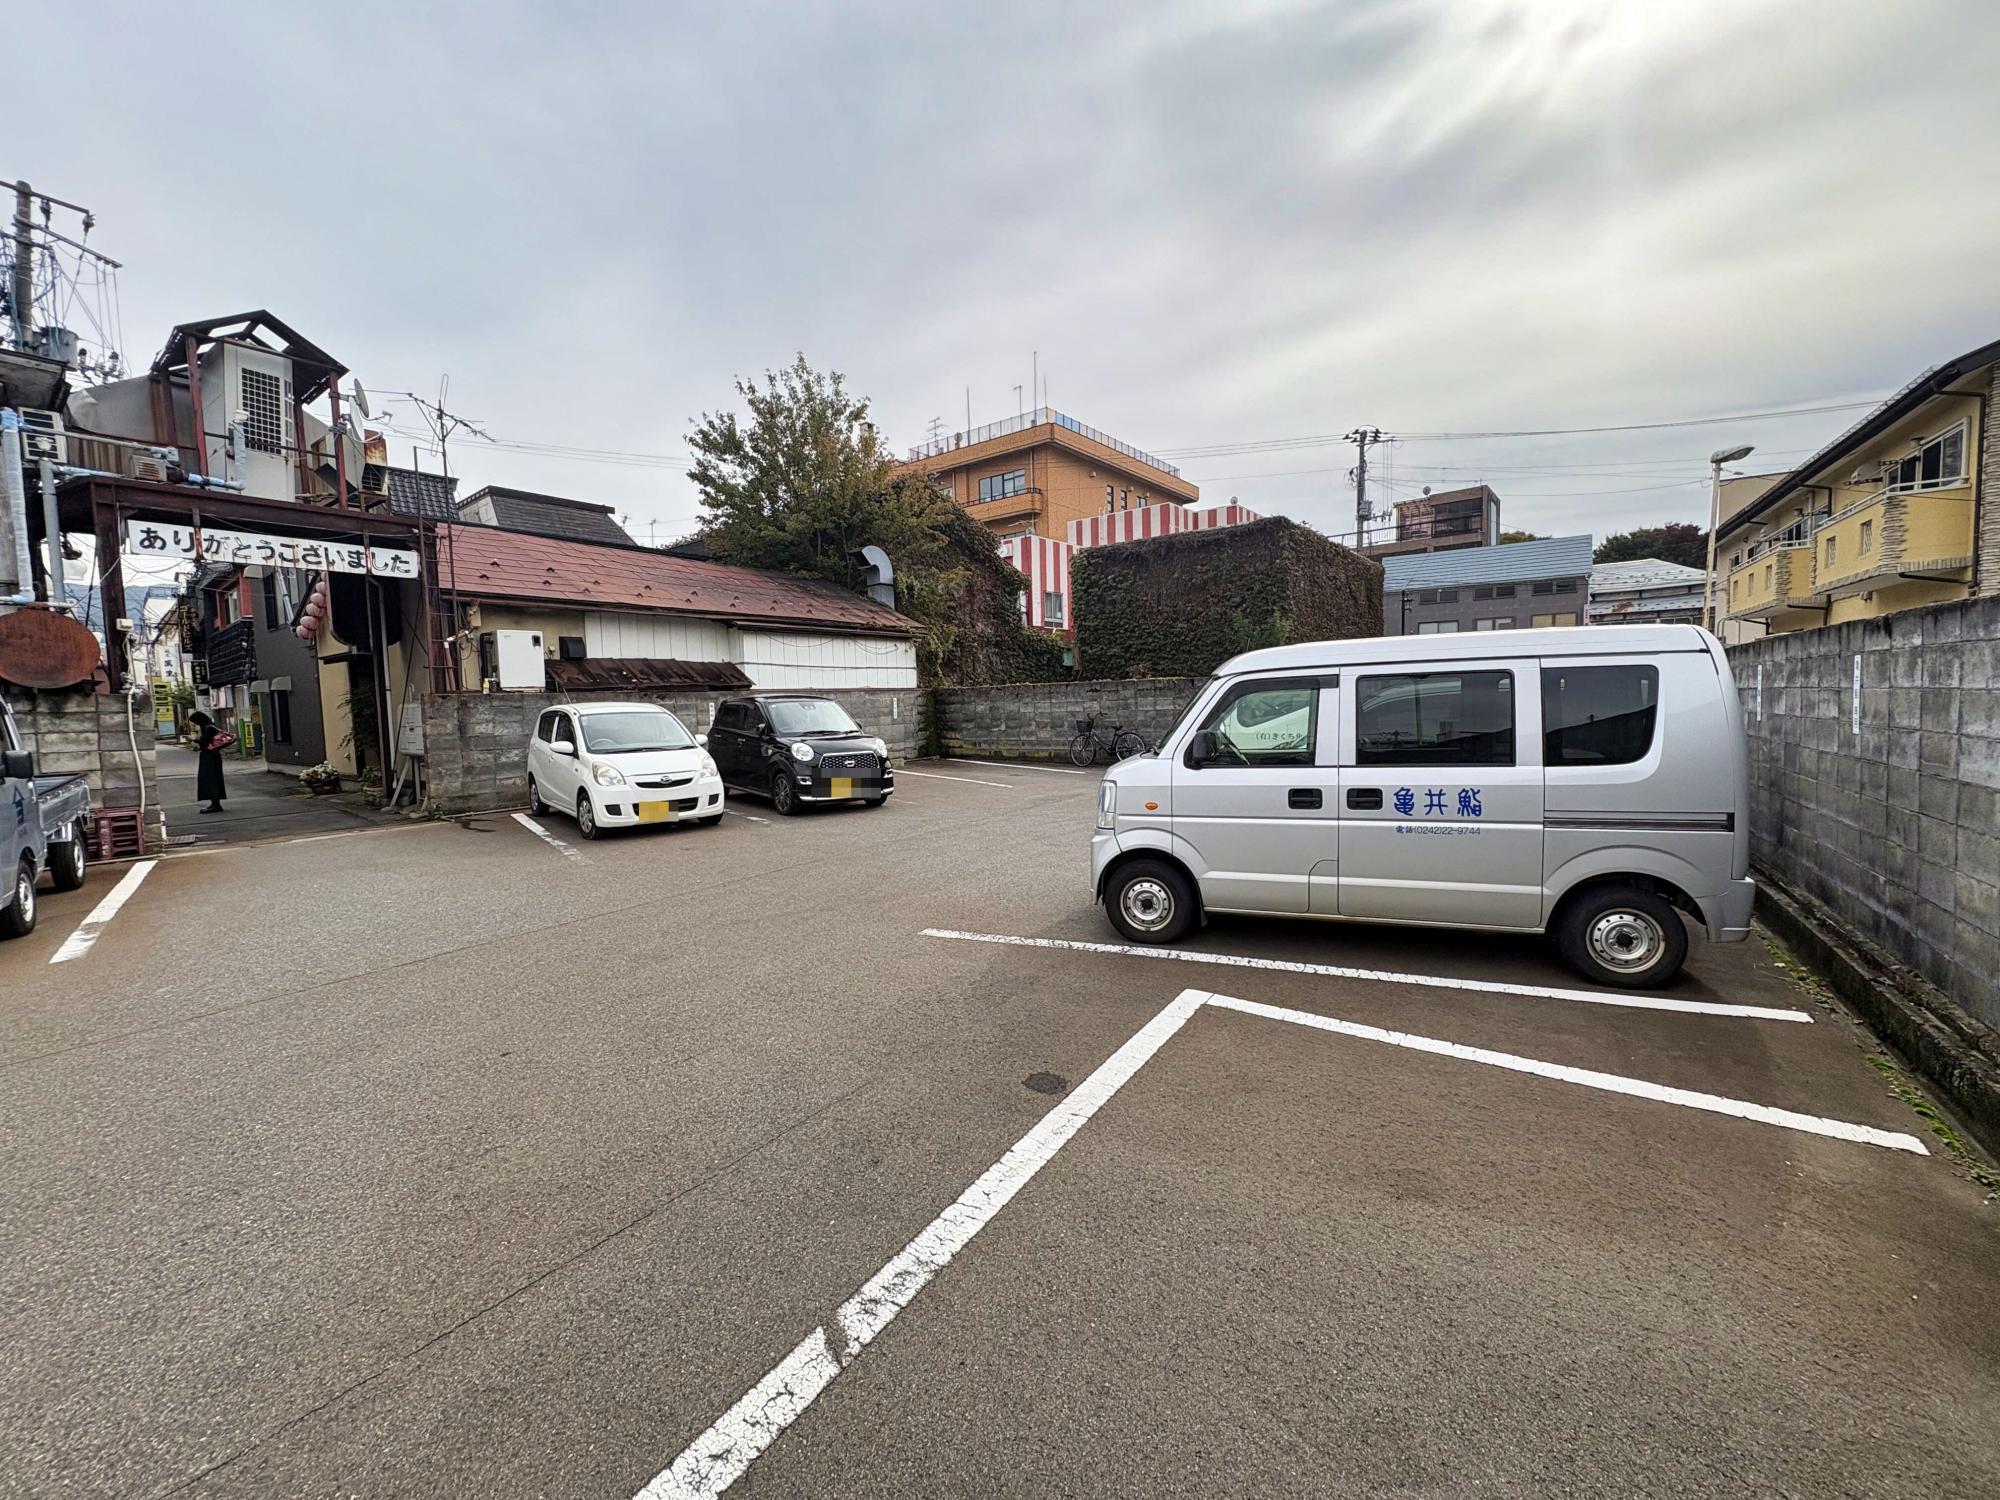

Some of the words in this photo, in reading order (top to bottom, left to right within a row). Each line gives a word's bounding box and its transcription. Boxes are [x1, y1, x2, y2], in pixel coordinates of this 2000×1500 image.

[139, 527, 411, 573] ありがとうございました
[1393, 786, 1482, 817] 亀井鮨
[1395, 825, 1481, 835] 電話(0242)22-9744
